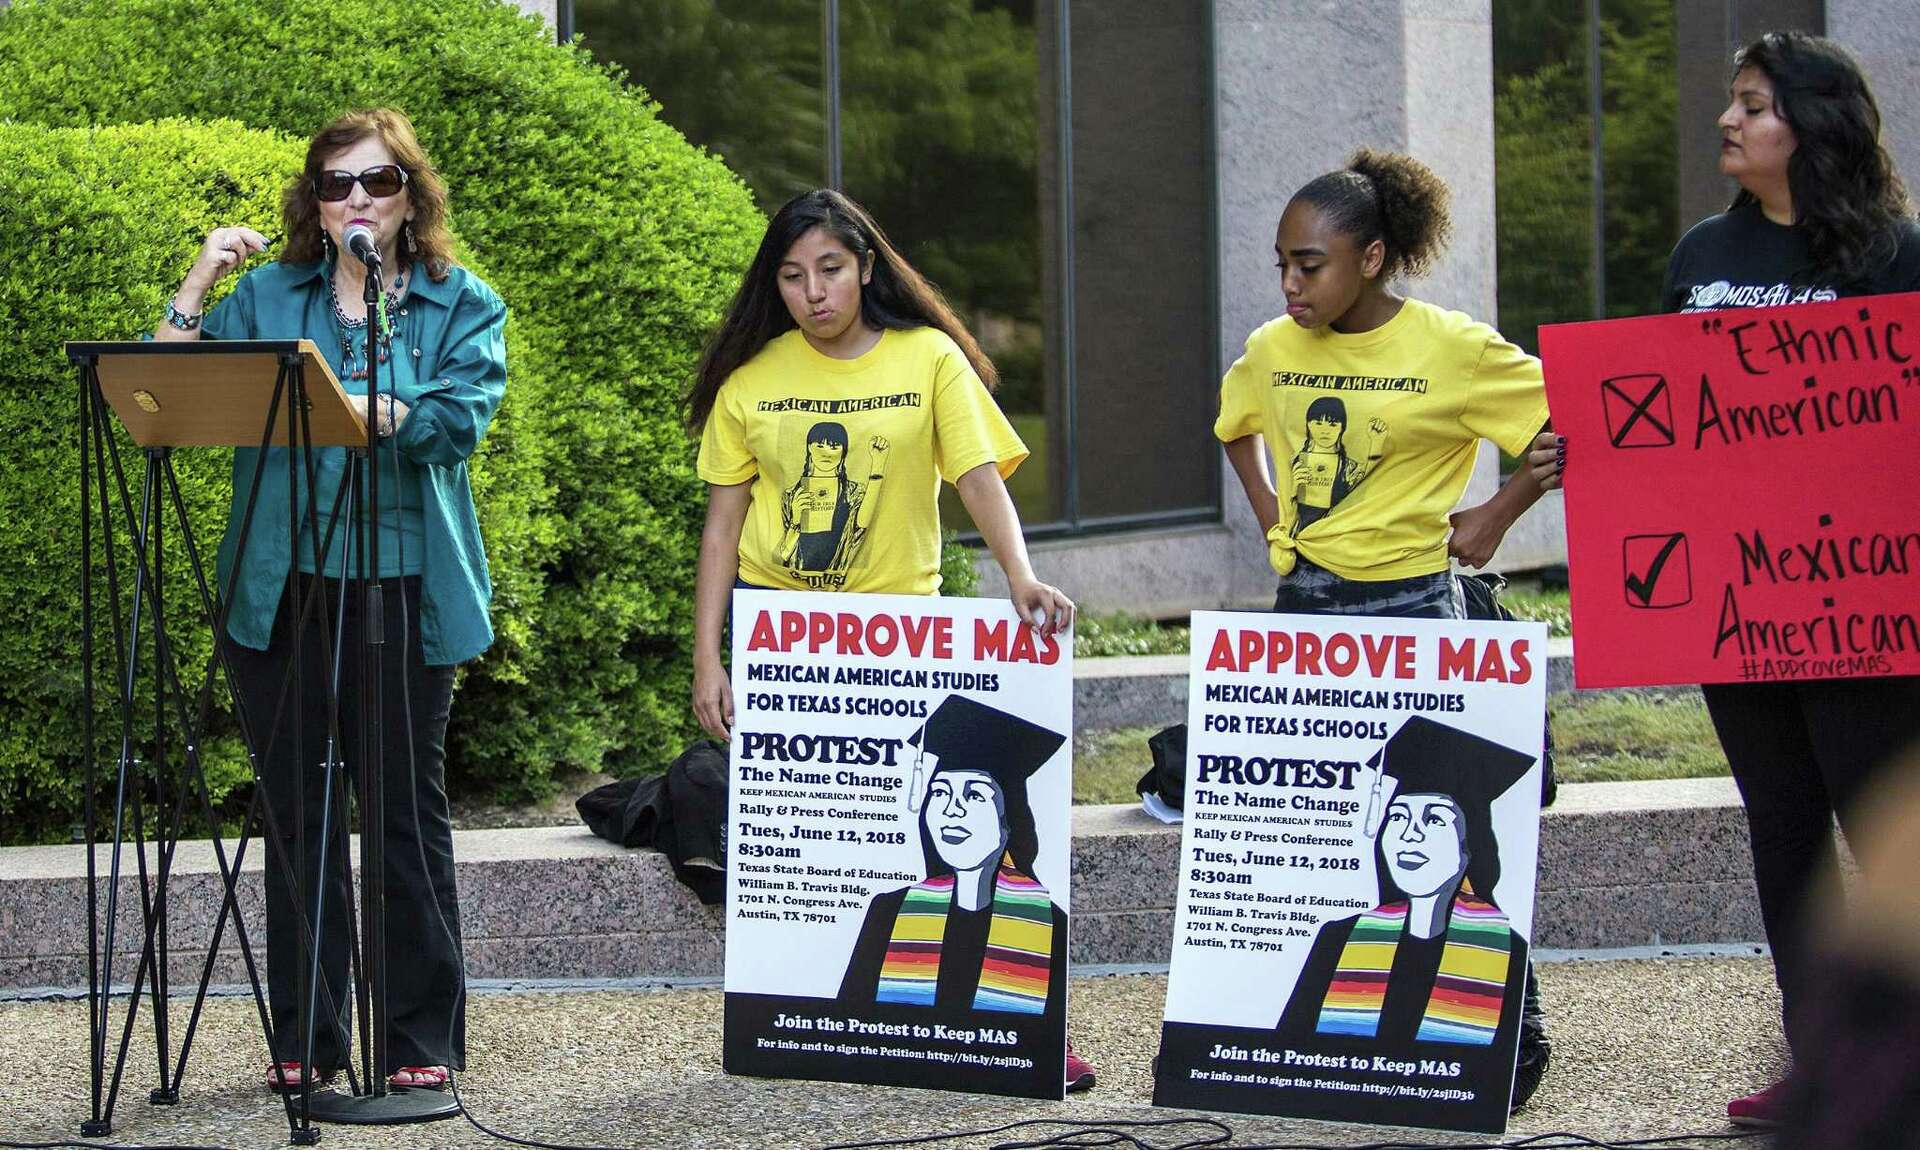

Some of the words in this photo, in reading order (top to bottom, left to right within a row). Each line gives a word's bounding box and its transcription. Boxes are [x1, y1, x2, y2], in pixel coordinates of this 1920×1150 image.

[1702, 307, 1912, 375] "Ethnic
[1341, 377, 1427, 393] AMERICAN
[758, 398, 831, 413] MEXICAN
[837, 393, 920, 413] AMERICAN
[1735, 513, 1920, 586] Mexican
[1713, 583, 1920, 659] American
[747, 610, 953, 659] APPROVE
[974, 619, 1060, 665] MAS
[1206, 629, 1416, 679] APPROVE
[1438, 638, 1532, 685] MAS
[748, 664, 829, 684] MEXICAN
[834, 668, 927, 688] AMERICAN
[932, 671, 999, 692] STUDIES
[748, 693, 784, 711] FOR
[788, 695, 841, 714] TEXAS
[846, 697, 927, 718] SCHOOLS
[1206, 684, 1288, 705] MEXICAN
[1292, 688, 1389, 709] AMERICAN
[1393, 692, 1465, 712] STUDIES
[1205, 714, 1241, 733] FOR
[1246, 716, 1298, 736] TEXAS
[1303, 719, 1388, 740] SCHOOLS
[740, 732, 903, 767] PROTEST
[739, 767, 774, 782] The
[779, 768, 831, 784] Name
[836, 771, 903, 791] Change
[1197, 755, 1361, 790] PROTEST
[740, 788, 763, 796] KEEP
[765, 790, 807, 798] MEXICAN
[809, 792, 856, 800] AMERICAN
[860, 795, 897, 803] STUDIES
[1195, 790, 1229, 806] The
[1234, 792, 1286, 809] Name
[1291, 795, 1359, 816] Change
[740, 804, 774, 817] Rally
[777, 806, 788, 815] &
[791, 806, 824, 817] Press
[828, 808, 898, 821] Conference
[1196, 812, 1218, 820] KEEP
[1220, 814, 1261, 823] MEXICAN
[1263, 817, 1311, 825] AMERICAN
[1314, 819, 1352, 828] STUDIES
[739, 823, 785, 841] Tues,
[790, 826, 832, 840] June
[837, 830, 861, 845] 12,
[866, 832, 905, 845] 2018
[1194, 828, 1227, 842] Rally
[1230, 830, 1242, 840] &
[1245, 831, 1278, 843] Press
[1282, 833, 1353, 847] Conference
[739, 843, 801, 858] 8:30am
[1193, 848, 1237, 867] Tues,
[1242, 851, 1285, 866] June
[1290, 856, 1314, 871] 12,
[1319, 858, 1360, 870] 2018
[738, 863, 771, 873] Texas
[774, 864, 804, 875] State
[807, 866, 841, 877] Board
[844, 869, 856, 878] of
[859, 869, 917, 882] Education
[1191, 869, 1252, 884] 8:30am
[738, 879, 784, 890] William
[787, 882, 798, 890] B.
[801, 882, 838, 893] Travis
[841, 885, 870, 897] Bldg.
[1190, 889, 1221, 899] Texas
[1224, 891, 1254, 902] State
[1257, 893, 1292, 904] Board
[1295, 896, 1307, 905] of
[1309, 896, 1369, 909] Education
[738, 895, 763, 904] 1701
[768, 895, 780, 904] N.
[783, 896, 835, 908] Congress
[838, 900, 863, 909] Ave.
[738, 909, 780, 922] Austin,
[783, 912, 800, 921] TX
[803, 914, 836, 924] 78701
[1188, 905, 1233, 917] William
[1236, 908, 1247, 918] B.
[1250, 910, 1287, 920] Travis
[1290, 912, 1319, 925] Bldg.
[1187, 922, 1211, 931] 1701
[1216, 922, 1228, 932] N.
[1231, 923, 1283, 936] Congress
[1286, 927, 1311, 937] Ave.
[1184, 936, 1226, 950] Austin,
[1230, 939, 1246, 949] TX
[1250, 942, 1283, 952] 78701
[774, 1014, 812, 1029] Join
[816, 1018, 844, 1031] the
[848, 1019, 909, 1036] Protest
[913, 1025, 930, 1038] to
[934, 1025, 975, 1044] Keep
[979, 1029, 1017, 1045] MAS
[758, 1038, 776, 1048] For
[778, 1040, 800, 1049] info
[802, 1042, 822, 1051] and
[823, 1044, 835, 1052] to
[837, 1044, 858, 1055] sign
[860, 1046, 878, 1055] the
[880, 1047, 925, 1059] Petition:
[1210, 1045, 1248, 1060] Join
[1252, 1048, 1280, 1063] the
[1284, 1050, 1347, 1068] Protest
[1350, 1057, 1369, 1070] to
[1372, 1057, 1416, 1076] Keep
[1419, 1060, 1461, 1076] MAS
[1190, 1069, 1210, 1079] For
[1210, 1071, 1233, 1081] info
[1234, 1074, 1255, 1083] and
[1257, 1076, 1268, 1084] to
[1270, 1076, 1292, 1087] sign
[1294, 1078, 1312, 1087] the
[1314, 1079, 1361, 1091] Petition:
